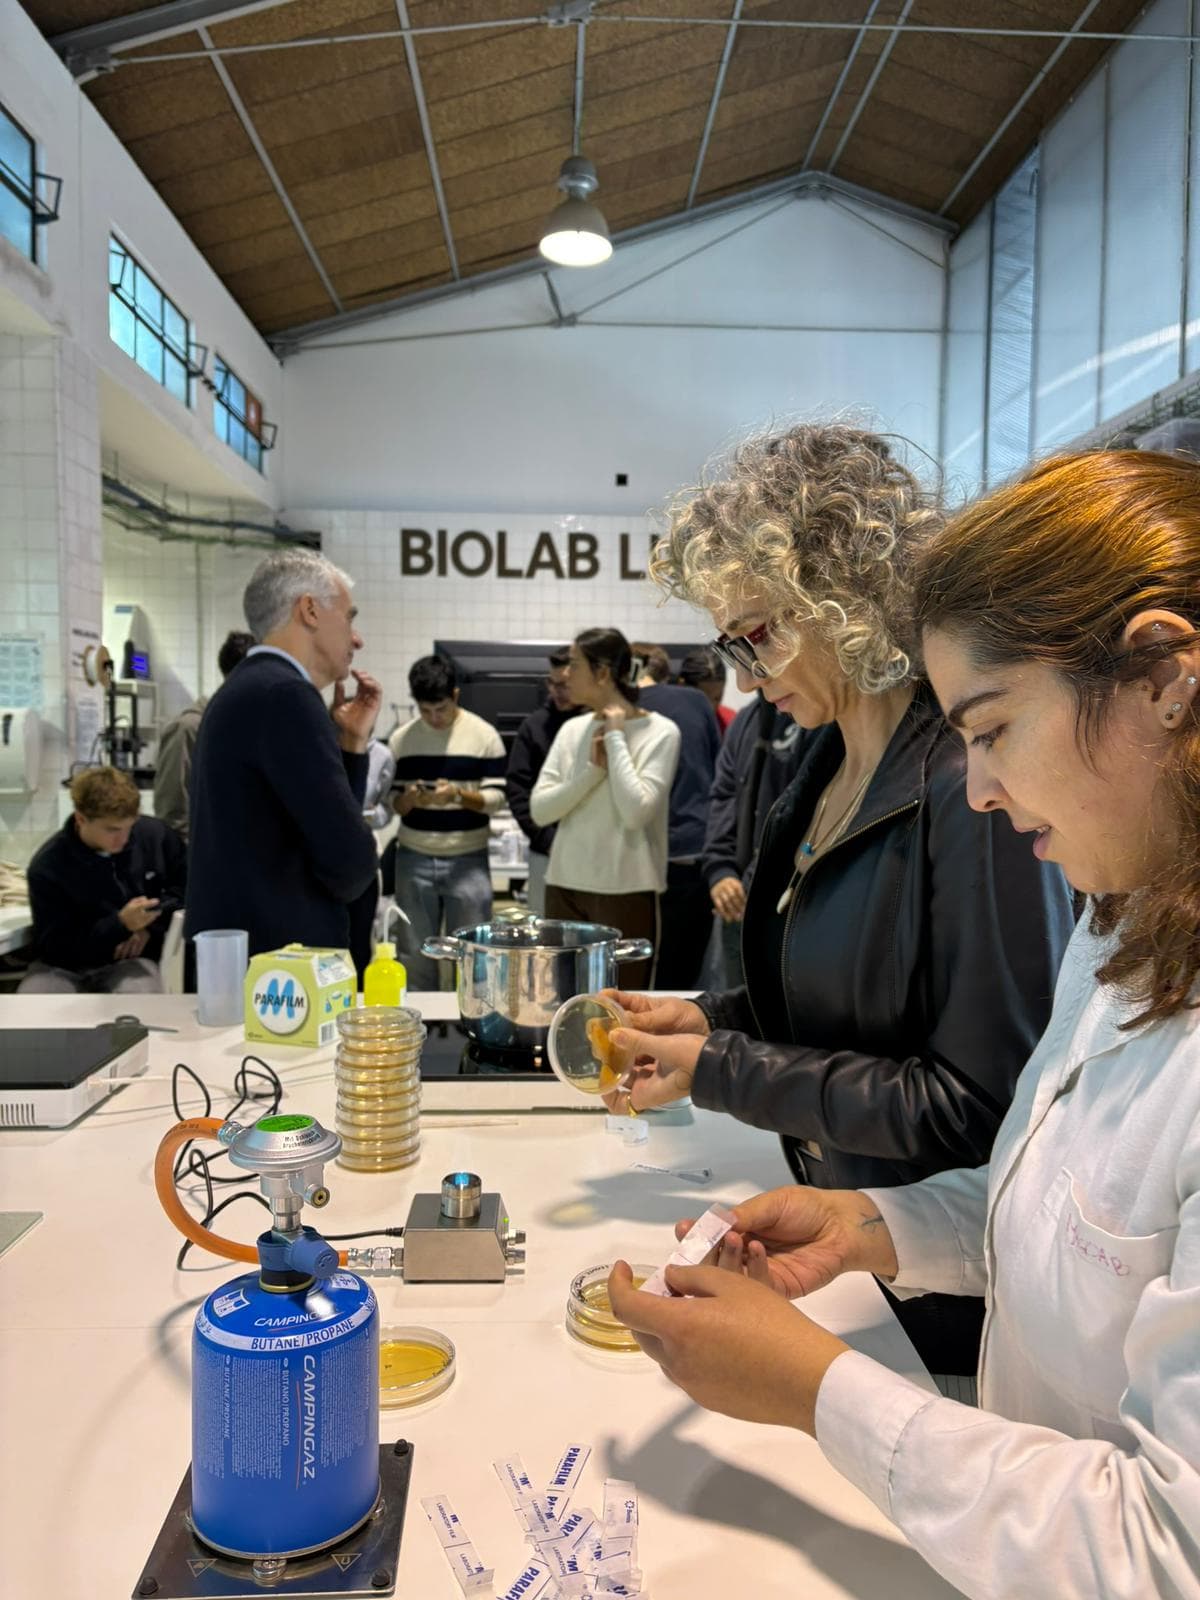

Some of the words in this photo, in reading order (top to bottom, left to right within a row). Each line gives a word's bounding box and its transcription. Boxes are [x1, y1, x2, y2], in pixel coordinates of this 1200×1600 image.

[400, 529, 600, 579] BIOLAB
[254, 993, 305, 1009] PARAFILM
[251, 1318, 356, 1350] BUTANE/PROPANE
[303, 1354, 316, 1479] CAMPINGAZ
[553, 1447, 581, 1485] PARAFILM
